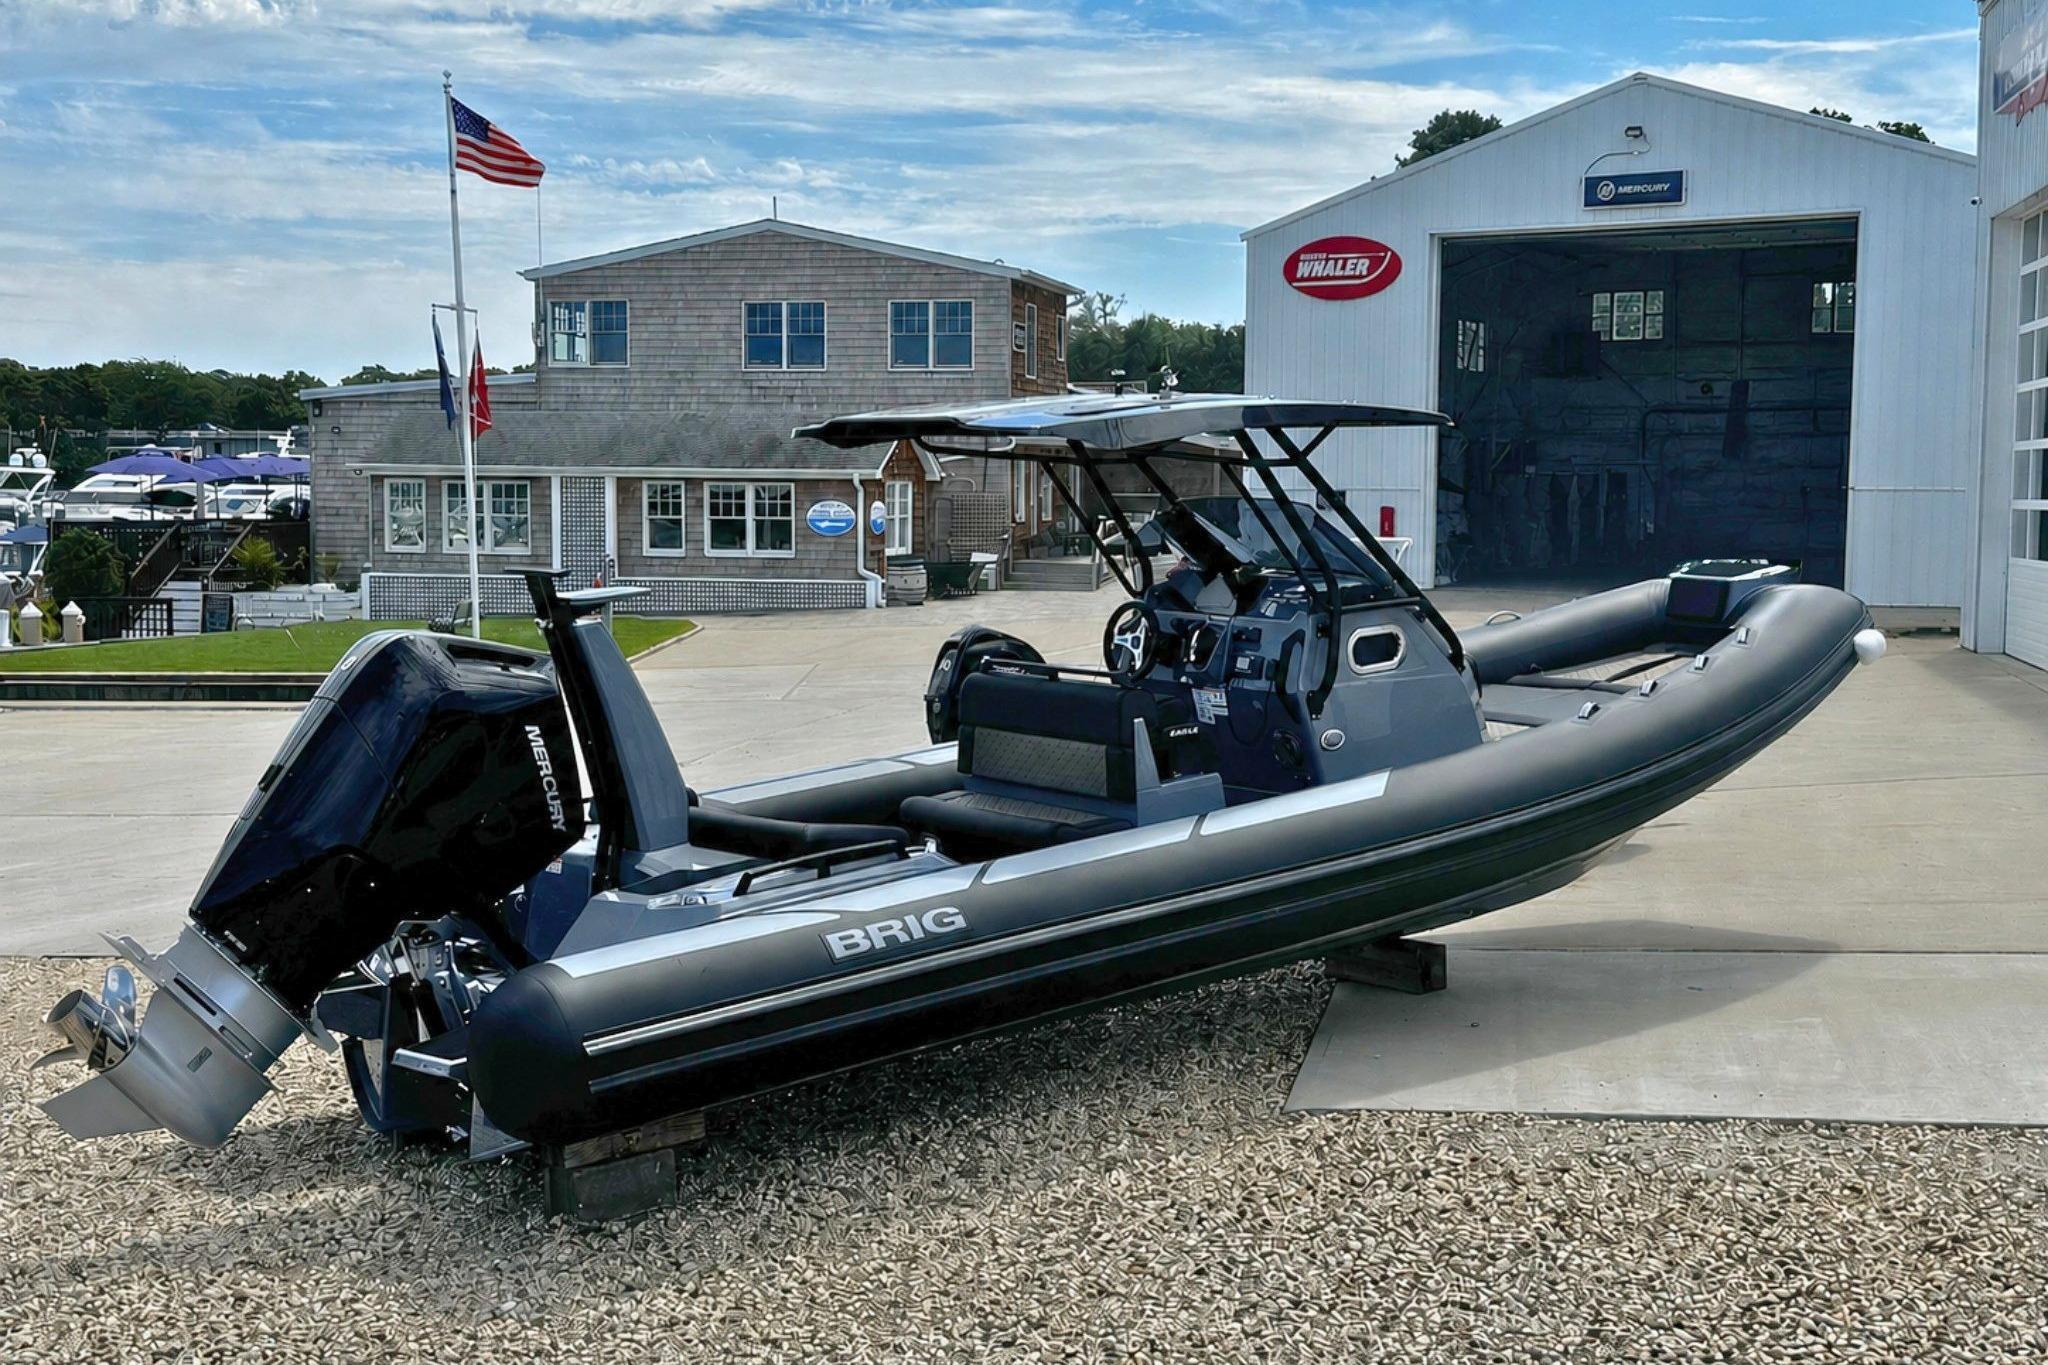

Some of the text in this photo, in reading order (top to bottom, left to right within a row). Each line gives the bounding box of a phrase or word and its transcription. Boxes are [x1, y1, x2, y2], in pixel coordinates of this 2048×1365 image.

[1617, 183, 1670, 194] MERCURY
[1296, 258, 1370, 278] WHALER
[524, 725, 567, 832] MERCURY
[825, 906, 967, 959] BRIG
